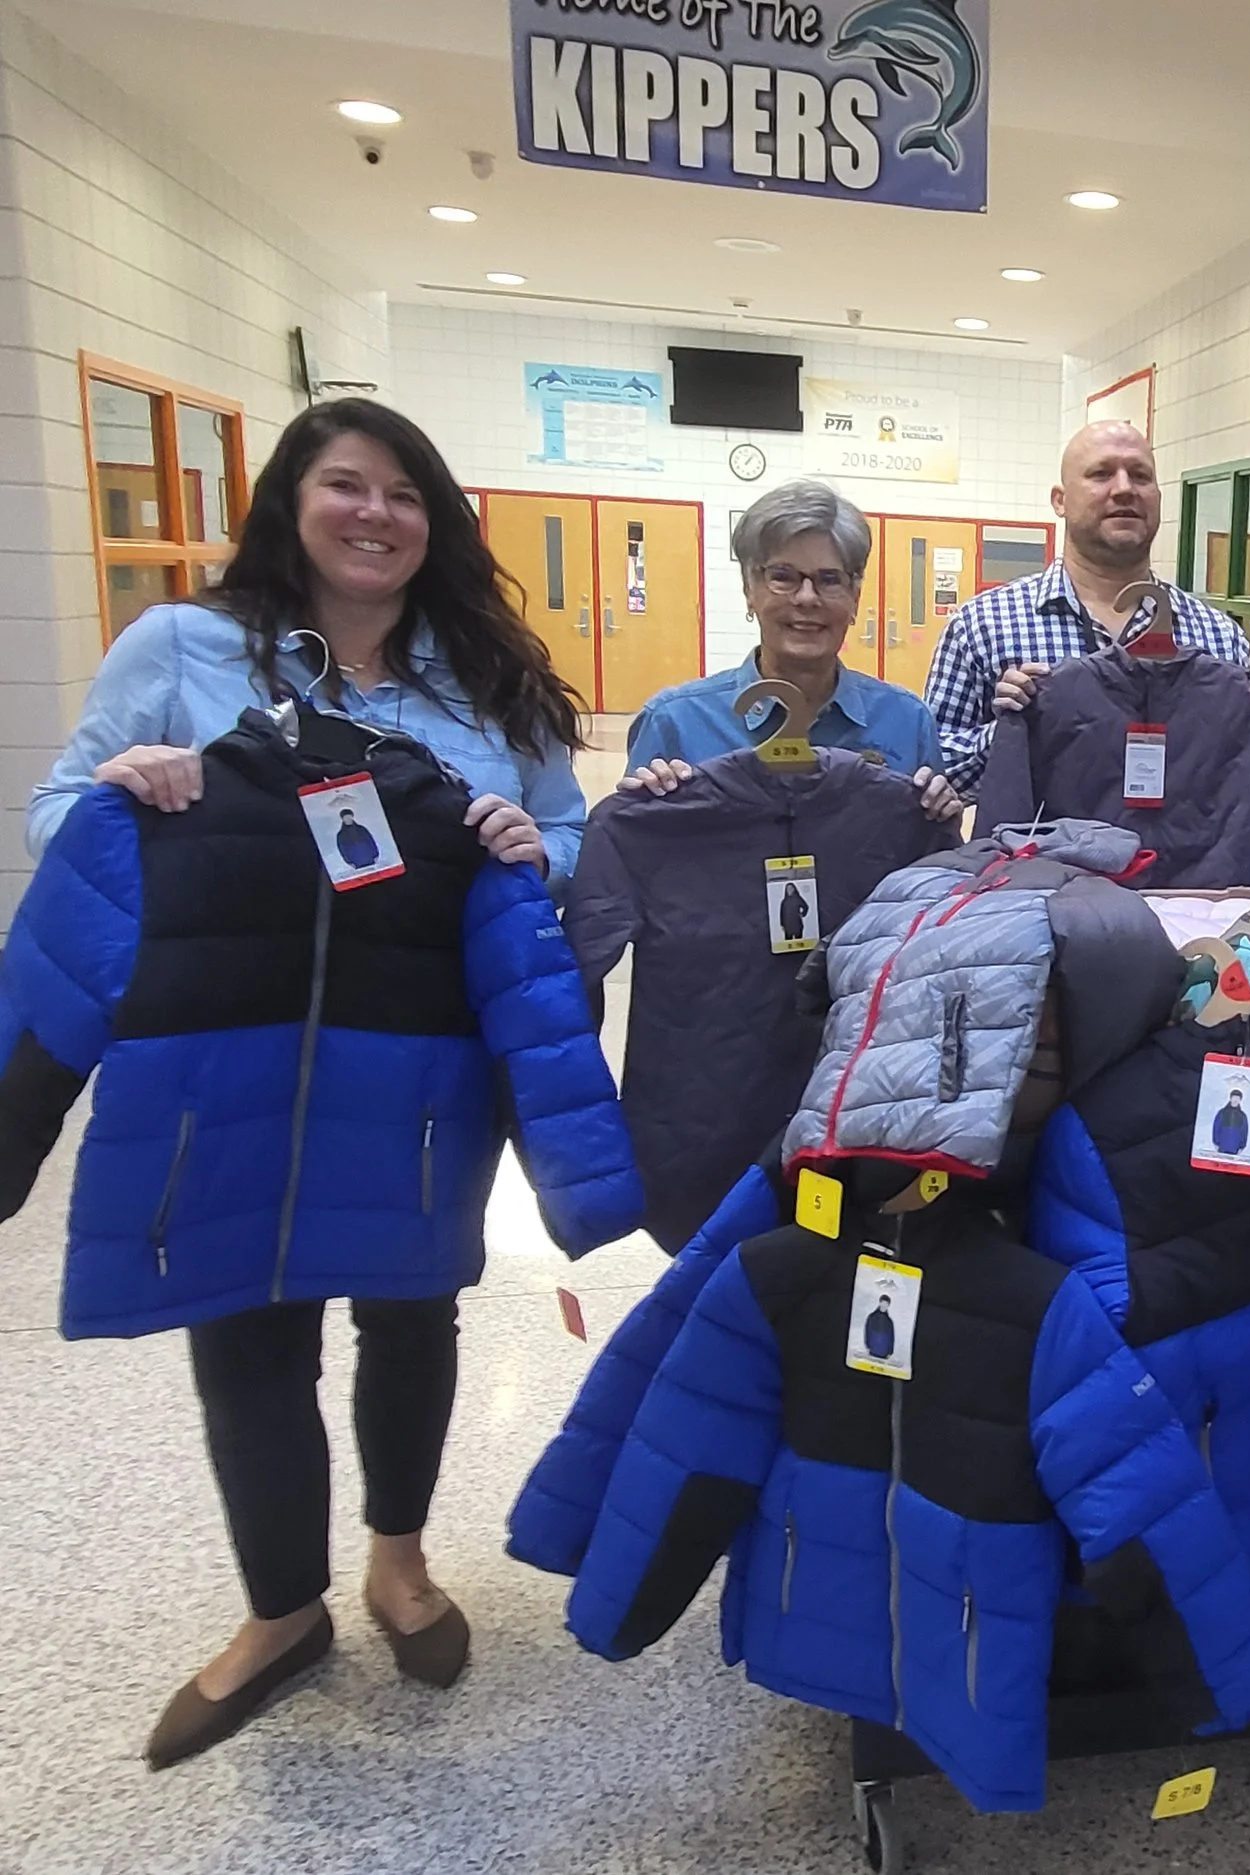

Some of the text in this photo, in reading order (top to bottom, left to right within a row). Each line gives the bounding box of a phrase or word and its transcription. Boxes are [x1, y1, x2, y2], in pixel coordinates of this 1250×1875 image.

[738, 0, 821, 43] The
[529, 36, 880, 191] KIPPERS
[881, 395, 893, 406] to
[824, 418, 853, 431] PTA
[901, 432, 943, 442] EXCELLENCE
[841, 452, 922, 472] 2018-2020
